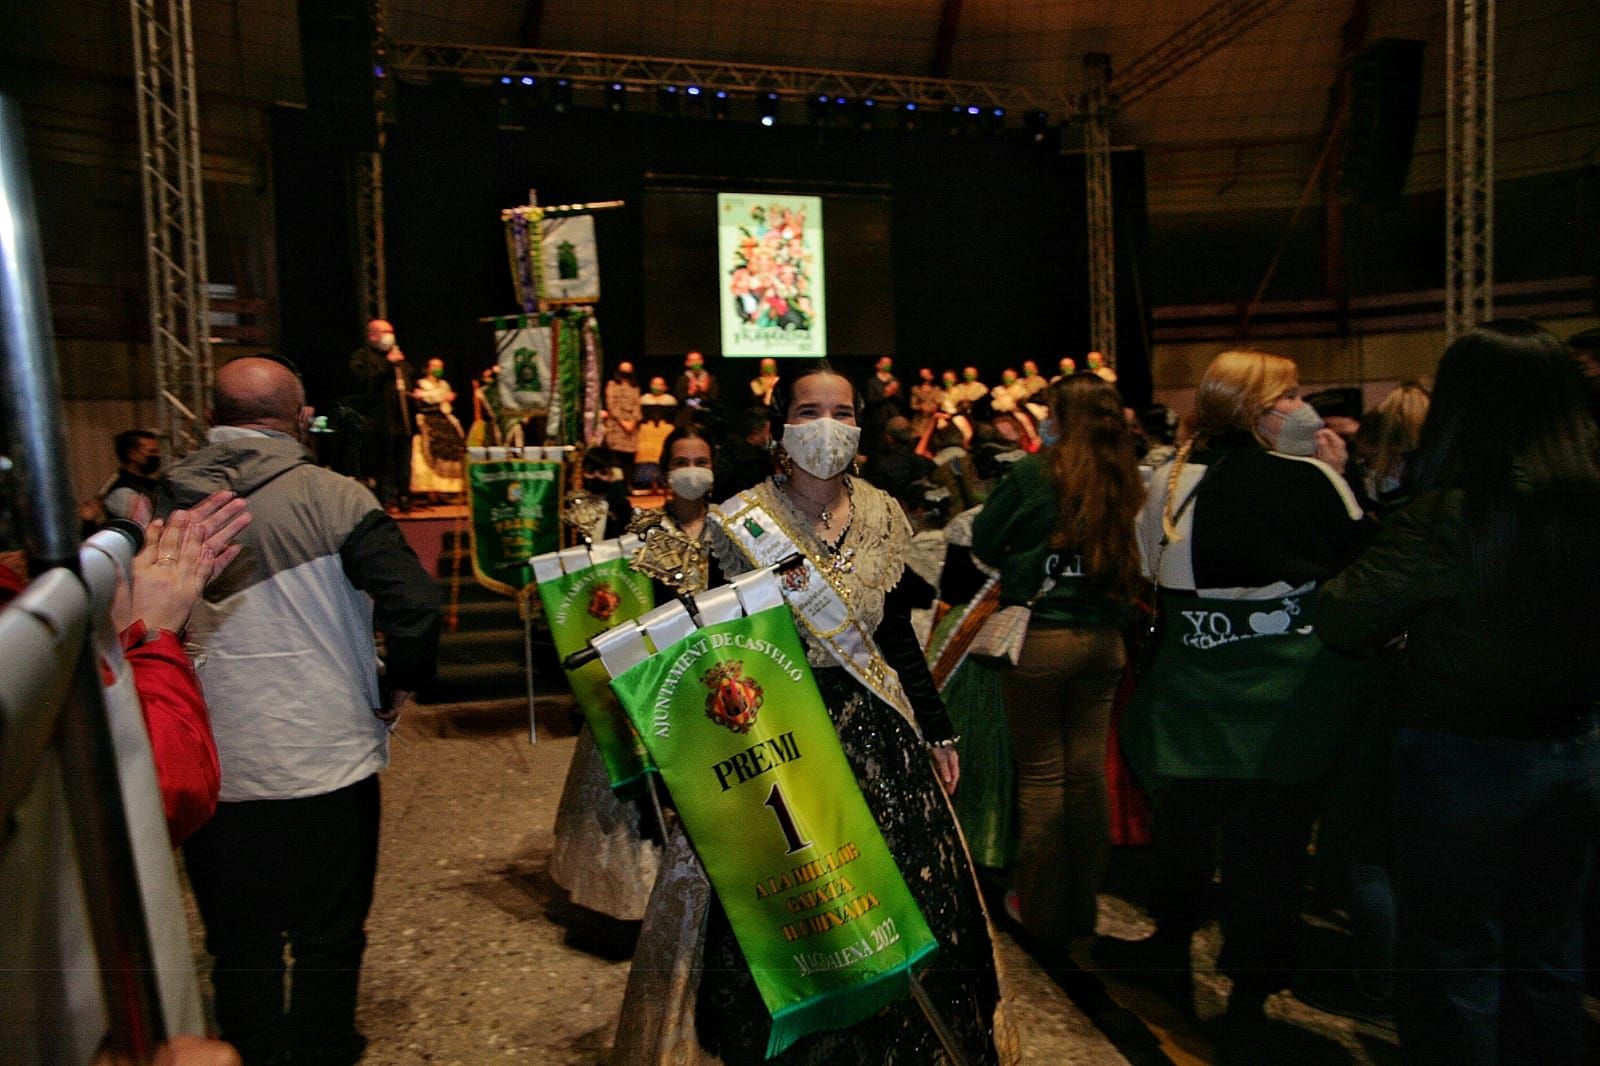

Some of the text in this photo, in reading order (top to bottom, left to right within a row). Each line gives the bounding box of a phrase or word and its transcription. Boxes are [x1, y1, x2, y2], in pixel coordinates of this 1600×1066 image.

[654, 636, 709, 739] AJUNTAMENT
[709, 632, 734, 649] DE
[711, 731, 802, 792] PREMI
[764, 781, 814, 856] 1
[871, 917, 900, 952] 2022
